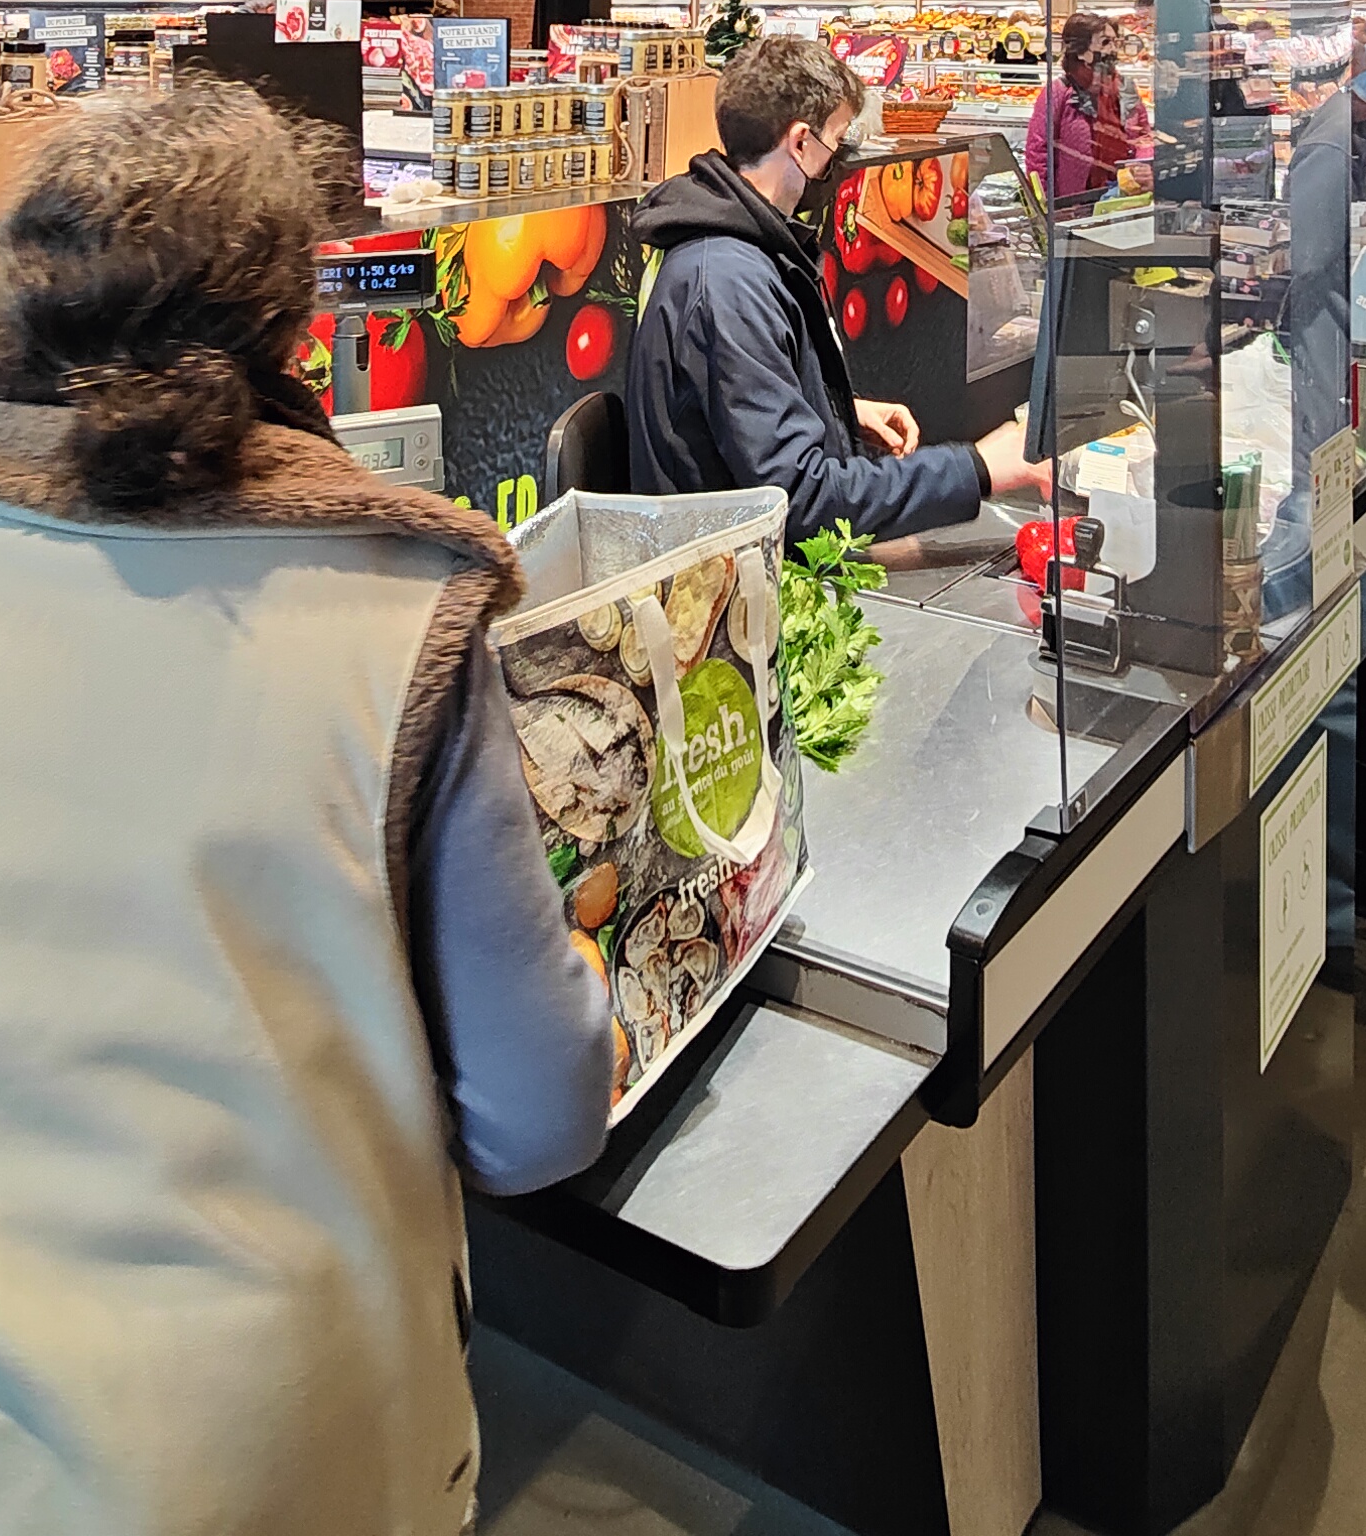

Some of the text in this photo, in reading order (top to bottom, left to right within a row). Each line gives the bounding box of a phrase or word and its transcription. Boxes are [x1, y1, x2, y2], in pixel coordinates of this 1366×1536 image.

[440, 26, 499, 36] NOTRE VIANDE
[445, 39, 454, 47] SE
[456, 38, 473, 46] MET
[482, 37, 494, 46] NU
[316, 267, 342, 279] LERI
[360, 265, 385, 276] 1,50
[371, 278, 397, 289] 0,42
[661, 703, 756, 793] fesh.
[678, 773, 713, 806] srvice
[714, 765, 727, 783] du
[730, 749, 755, 776] goût
